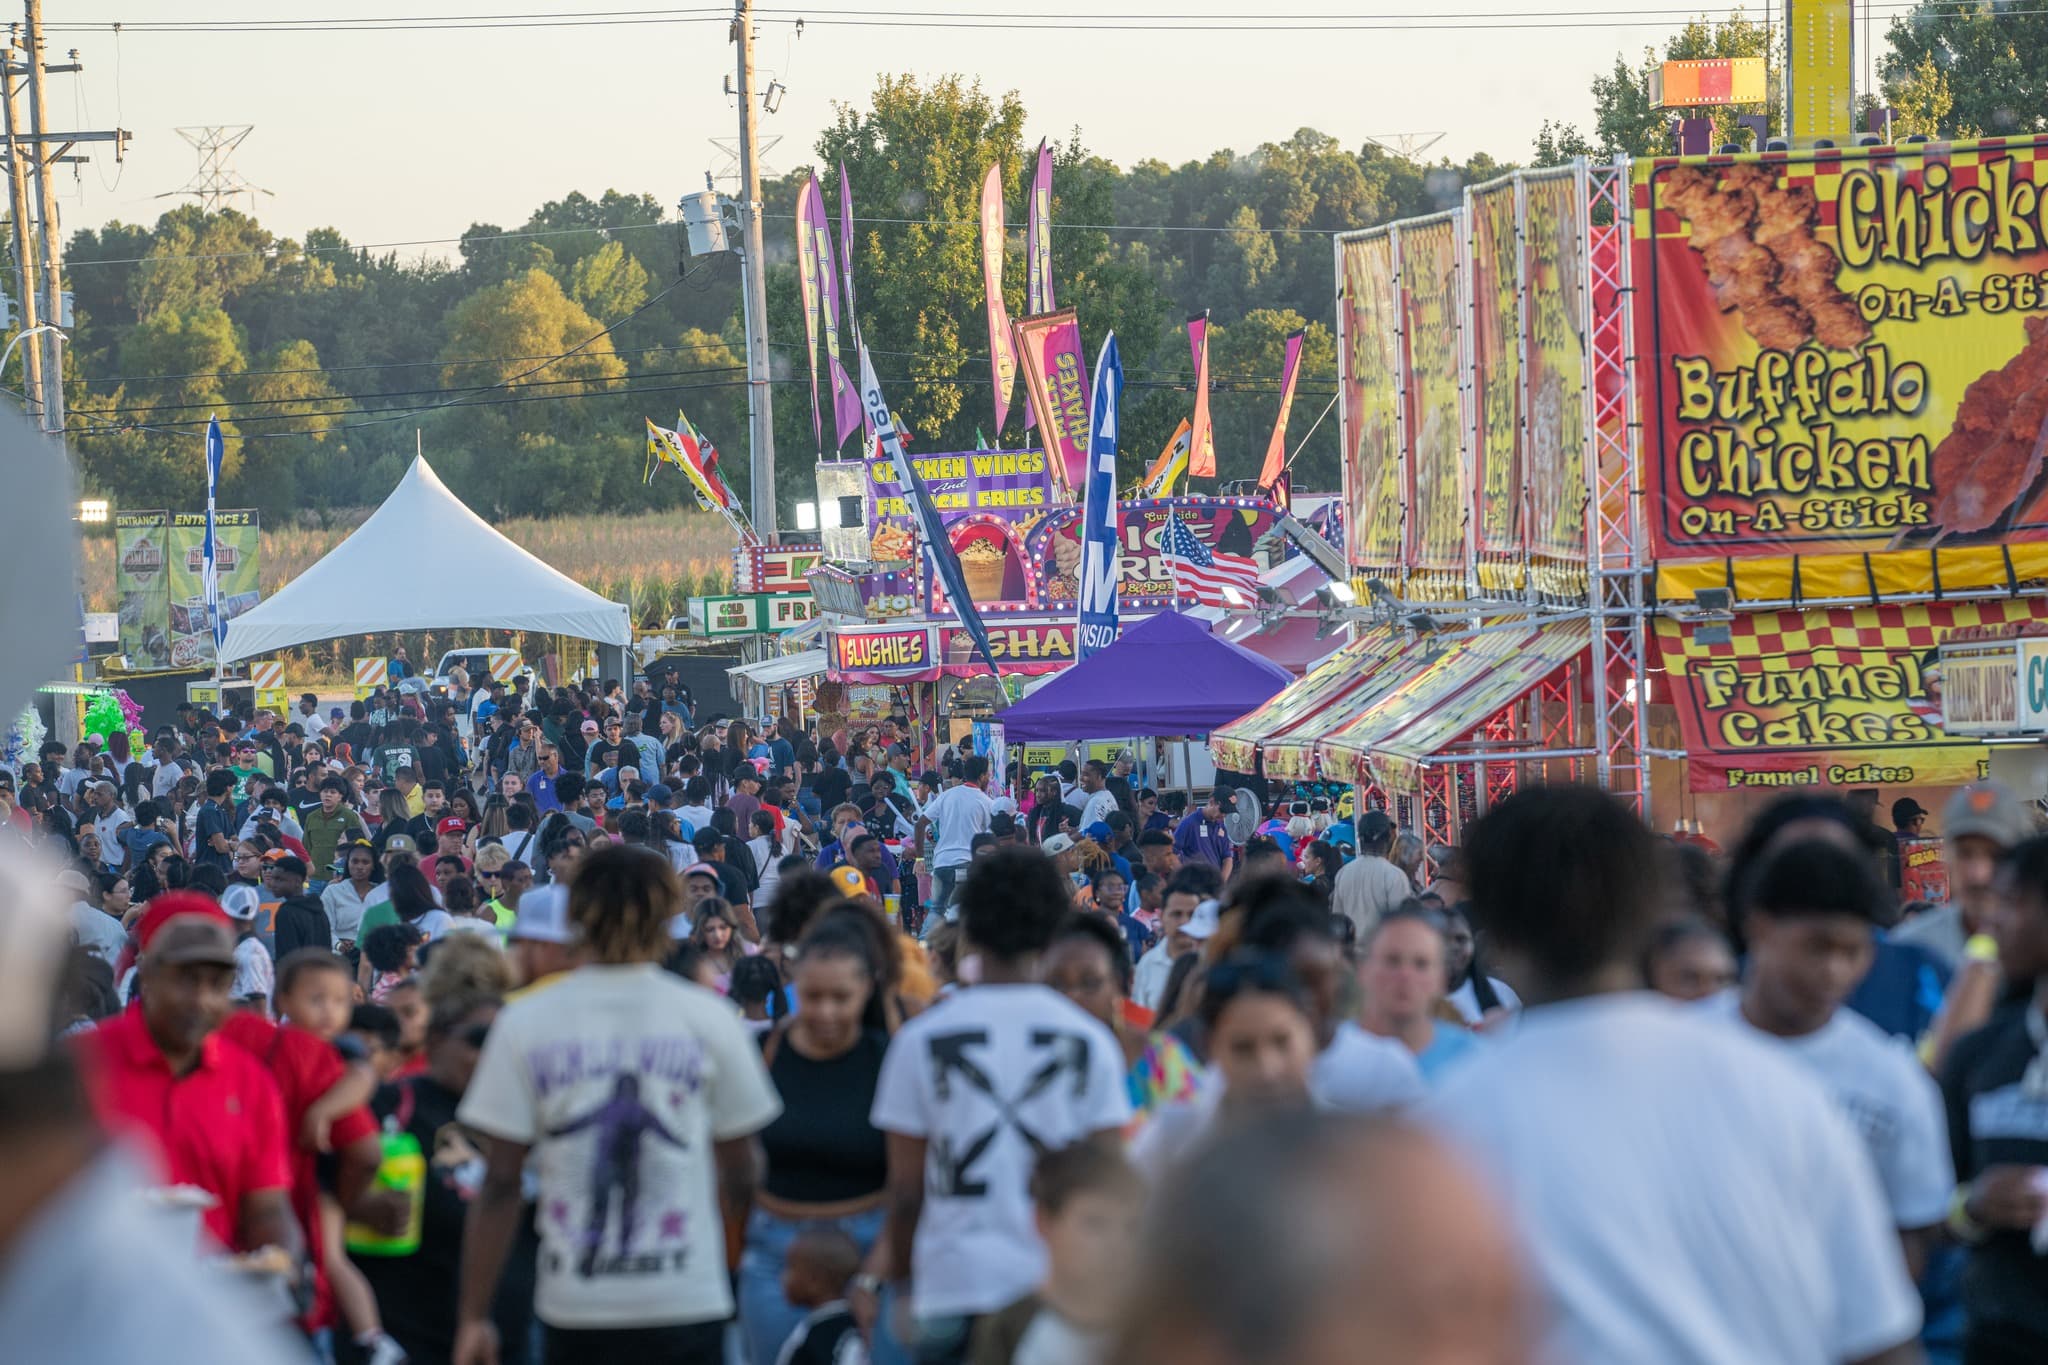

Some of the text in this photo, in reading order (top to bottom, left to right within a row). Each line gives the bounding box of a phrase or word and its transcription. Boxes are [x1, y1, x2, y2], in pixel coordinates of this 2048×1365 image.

[1055, 351, 1089, 451] SHAKES
[1674, 344, 1927, 423] Buffalo
[971, 451, 1046, 478] WINGS
[1678, 423, 1932, 498] Chicken
[932, 479, 969, 493] And
[976, 487, 1045, 507] FRIES
[174, 513, 249, 526] ENTRNCE 2
[1680, 494, 1929, 535] On-A-Stick
[846, 633, 923, 668] SLUSHIES
[1696, 654, 1926, 709] Funnel
[1720, 701, 1935, 747] Cakes
[1726, 765, 1914, 788] Funnel Cakes
